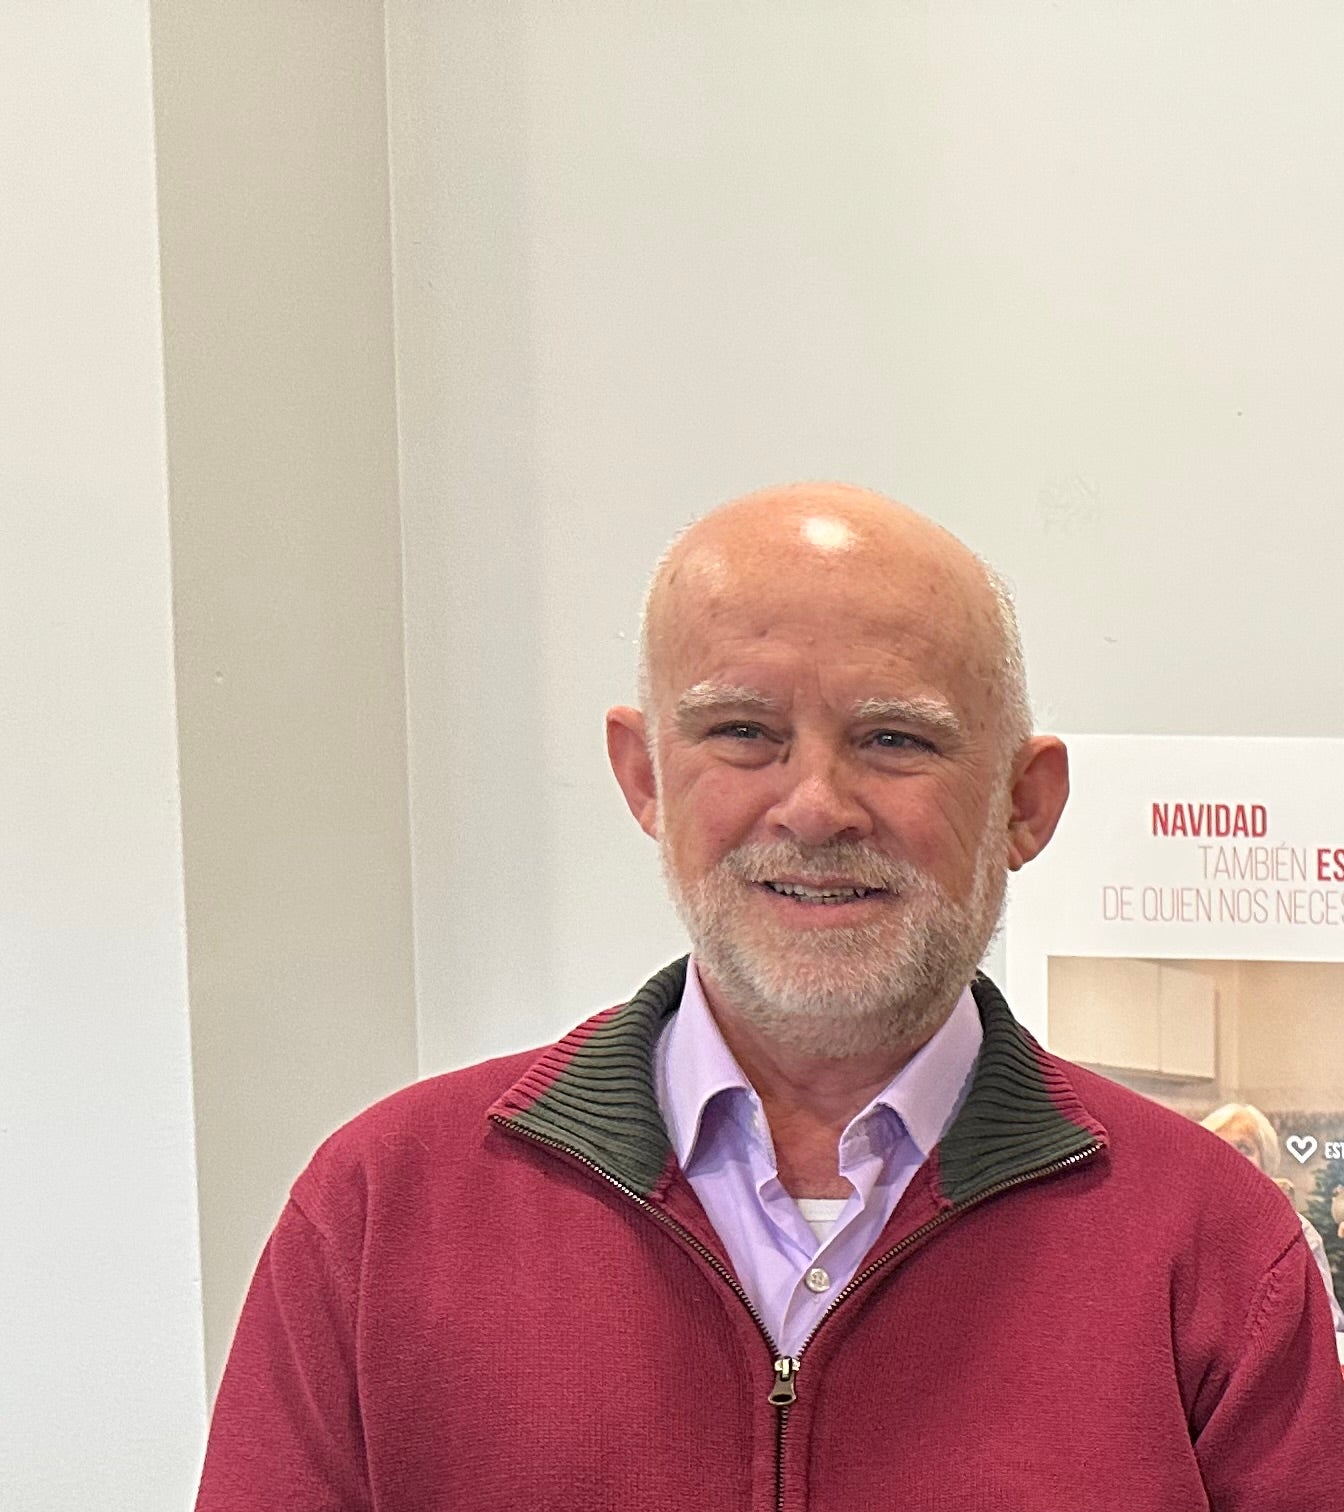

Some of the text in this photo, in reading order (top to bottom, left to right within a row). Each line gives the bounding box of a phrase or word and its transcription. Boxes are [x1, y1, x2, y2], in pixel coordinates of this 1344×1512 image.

[1151, 802, 1268, 838] NAVIDAD
[1198, 841, 1308, 882] TAMBIÉN
[1102, 885, 1135, 922] DE
[1142, 886, 1213, 924] QUIEN
[1218, 887, 1269, 925] NOS
